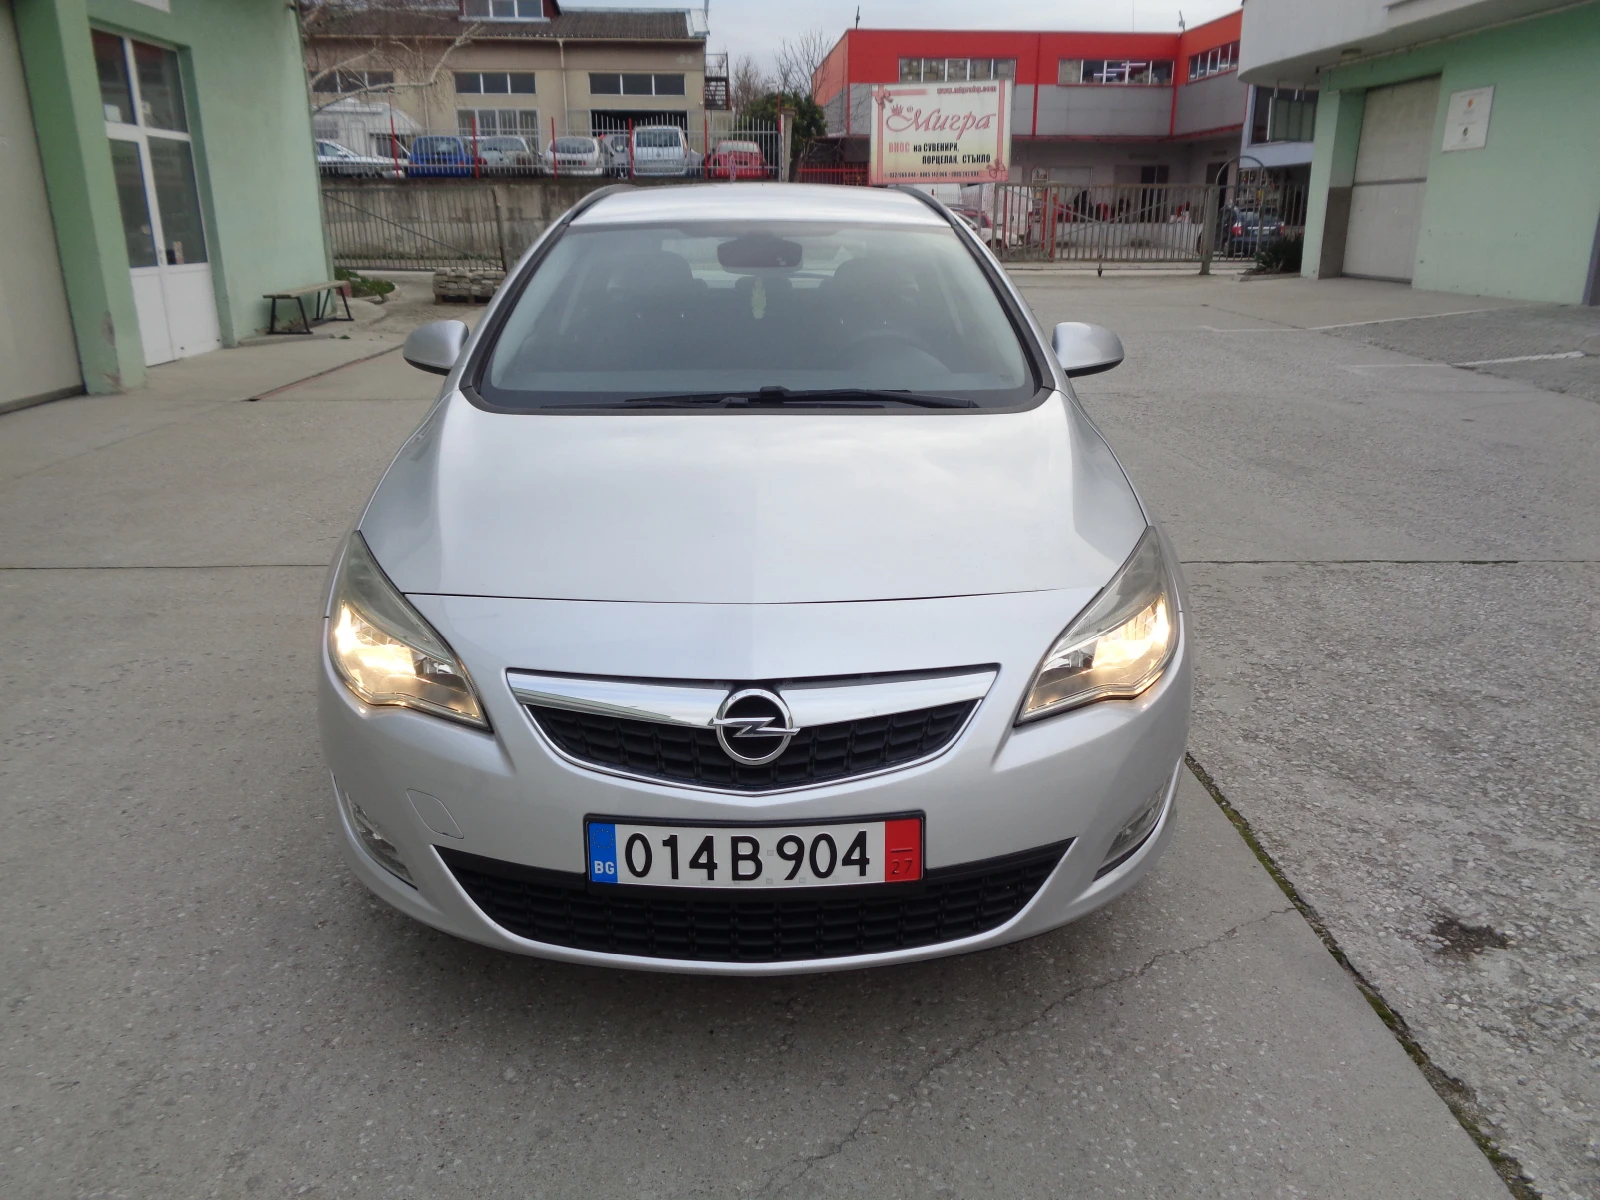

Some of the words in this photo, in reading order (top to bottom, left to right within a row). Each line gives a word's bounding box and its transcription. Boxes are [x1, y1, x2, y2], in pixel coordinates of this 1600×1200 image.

[886, 107, 996, 140] Мигра
[888, 141, 910, 153] ВНОС
[913, 144, 922, 153] на
[962, 154, 991, 164] СТЪКЛО
[594, 860, 615, 875] BG
[891, 857, 913, 875] 27
